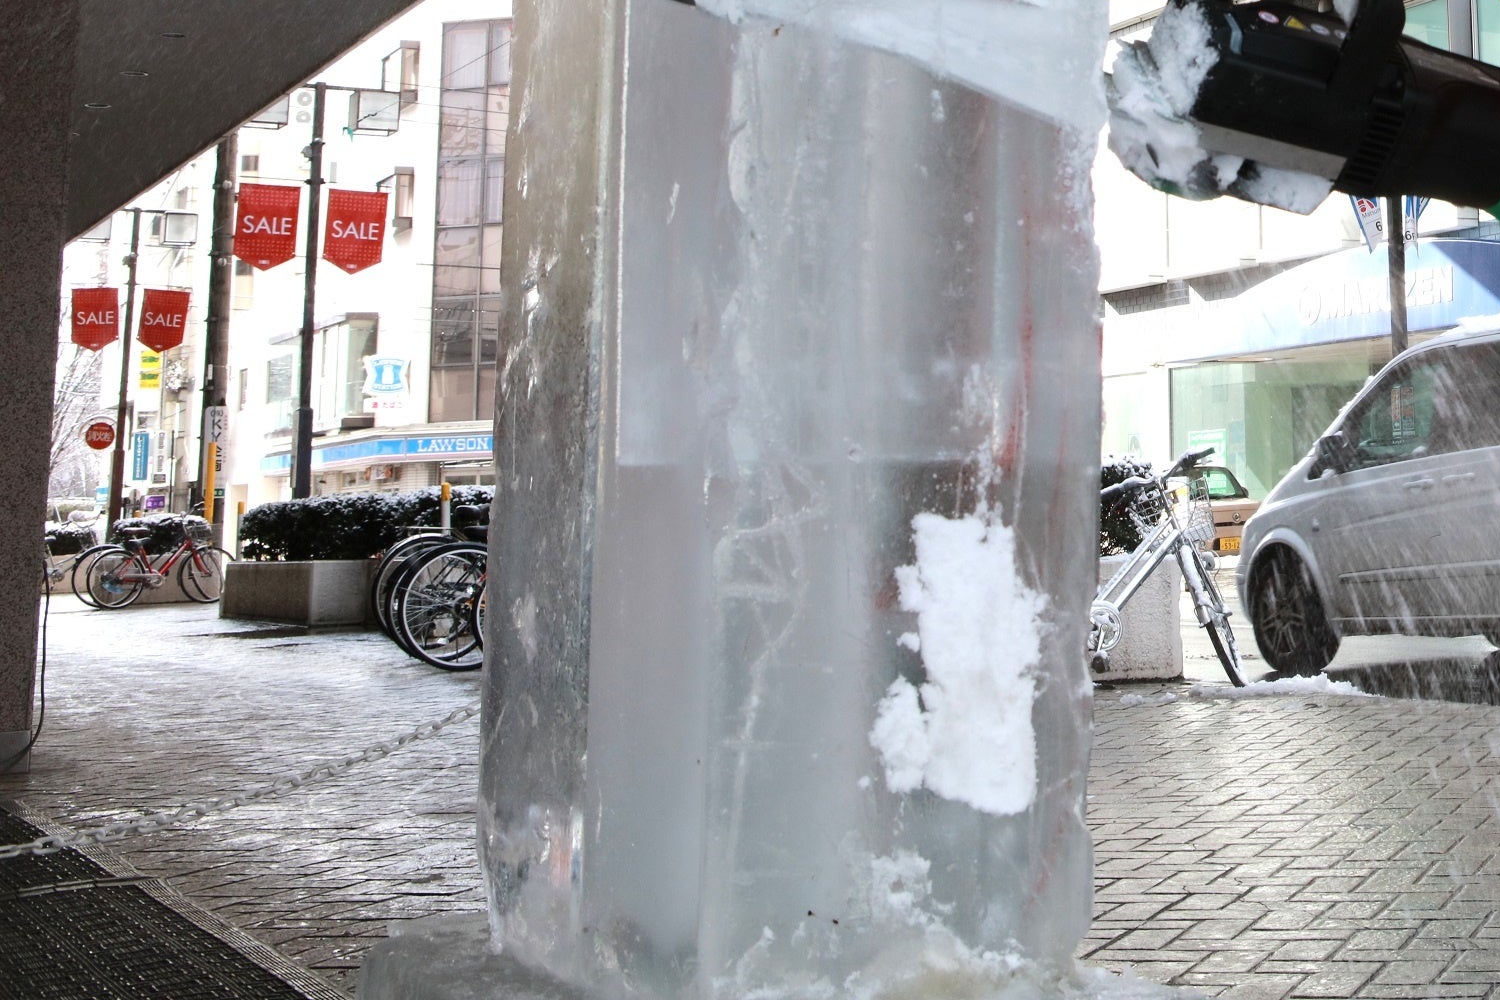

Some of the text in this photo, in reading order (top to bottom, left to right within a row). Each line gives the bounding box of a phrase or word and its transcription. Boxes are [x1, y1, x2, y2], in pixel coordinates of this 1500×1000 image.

[242, 215, 293, 236] SALE
[331, 220, 380, 241] SALE
[76, 310, 115, 326] SALE
[144, 311, 183, 328] SALE
[417, 437, 489, 453] LAWSON
